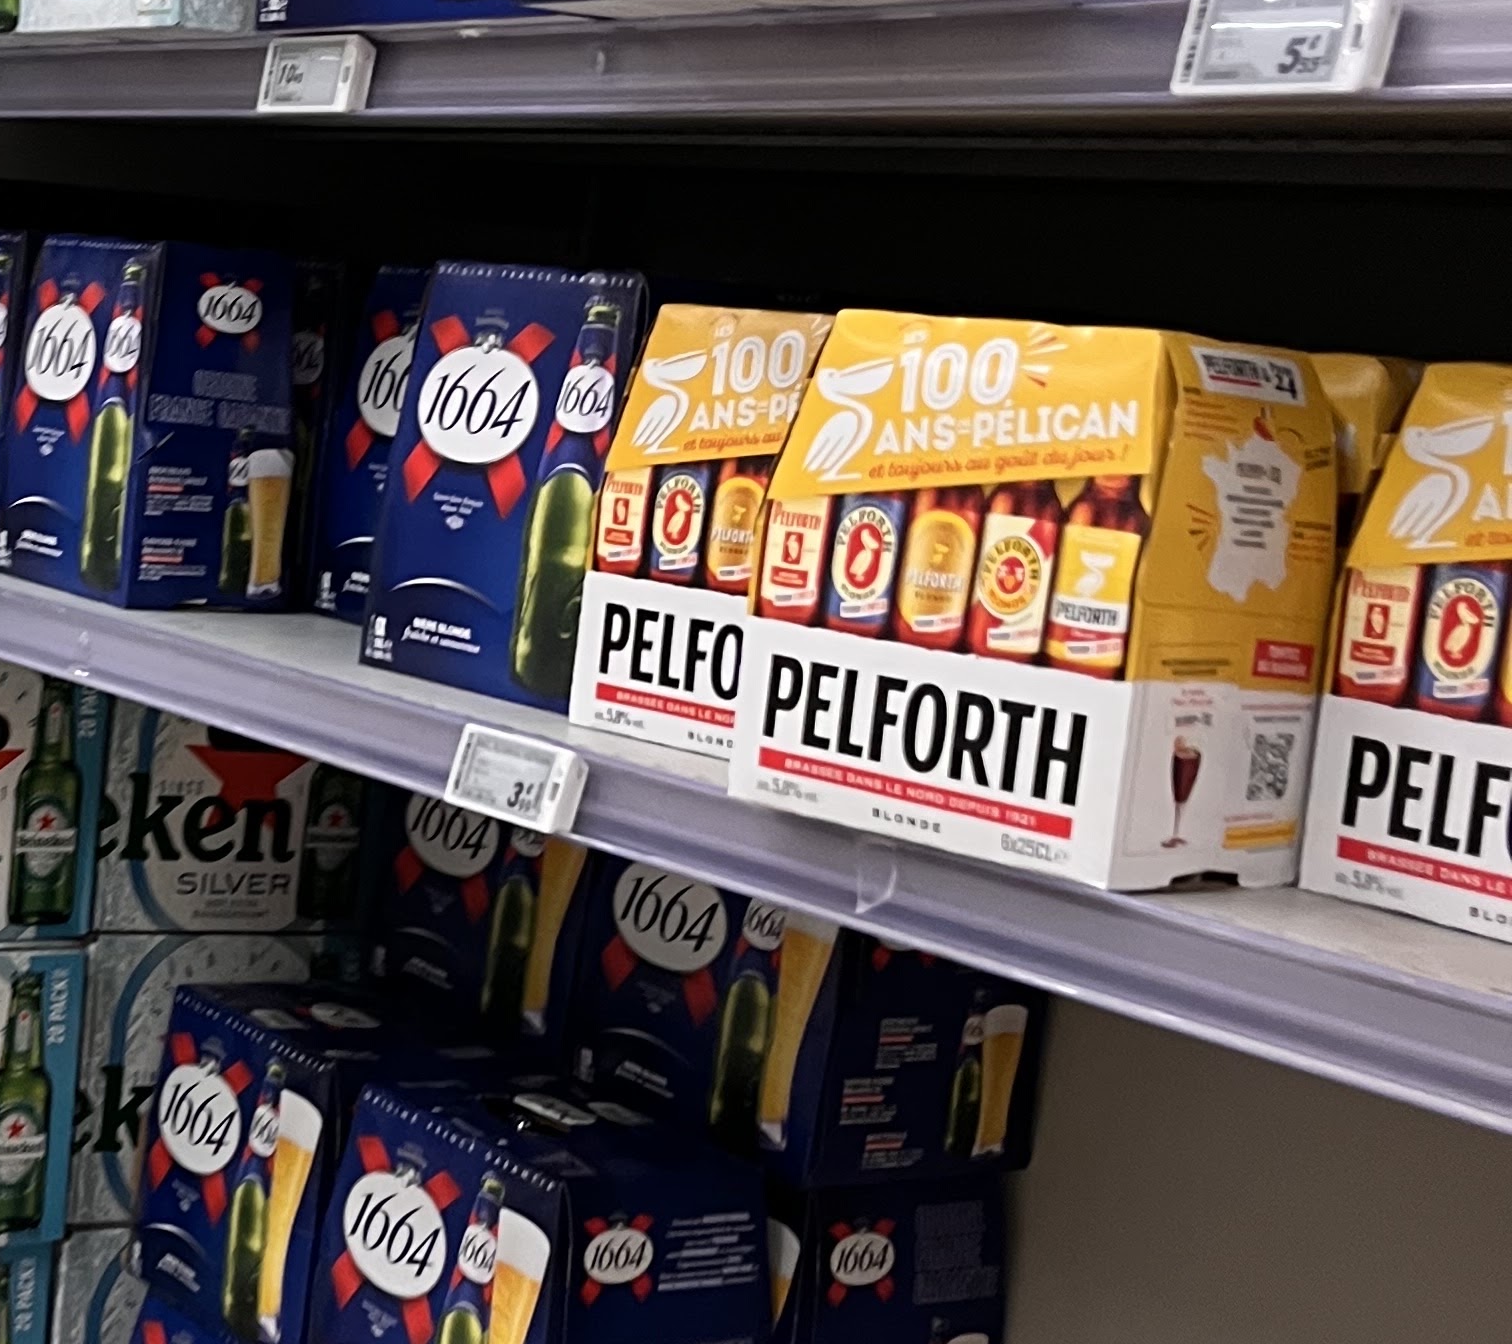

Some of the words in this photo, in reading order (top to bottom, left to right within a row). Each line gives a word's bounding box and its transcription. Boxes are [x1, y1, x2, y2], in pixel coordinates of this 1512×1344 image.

[203, 291, 258, 324] 1664
[26, 319, 94, 379] 1664
[710, 328, 807, 397] 100
[558, 376, 614, 417] 1664
[899, 337, 1020, 414] 100
[425, 364, 531, 439] 1664
[656, 474, 701, 515] PELFORTH
[771, 501, 822, 531] PELFORTH
[835, 507, 893, 553] PELFORTH
[1055, 600, 1120, 628] PELFORTH
[1427, 580, 1494, 628] PELFORTH
[599, 602, 744, 701] PELFO
[761, 653, 1088, 807] PELFORTH
[846, 770, 884, 792] DANS
[884, 779, 904, 796] LE
[905, 787, 945, 807] NORD
[948, 796, 1002, 820] DEPUIS
[1341, 734, 1512, 857] PELF
[411, 798, 488, 858] 1664
[872, 808, 942, 834] BLONDE
[177, 871, 292, 895] SILVER
[620, 874, 717, 953] 1664
[165, 1080, 239, 1157] 1664
[351, 1191, 442, 1277] 1664
[589, 1237, 648, 1272] 1664
[835, 1243, 892, 1274] 1664
